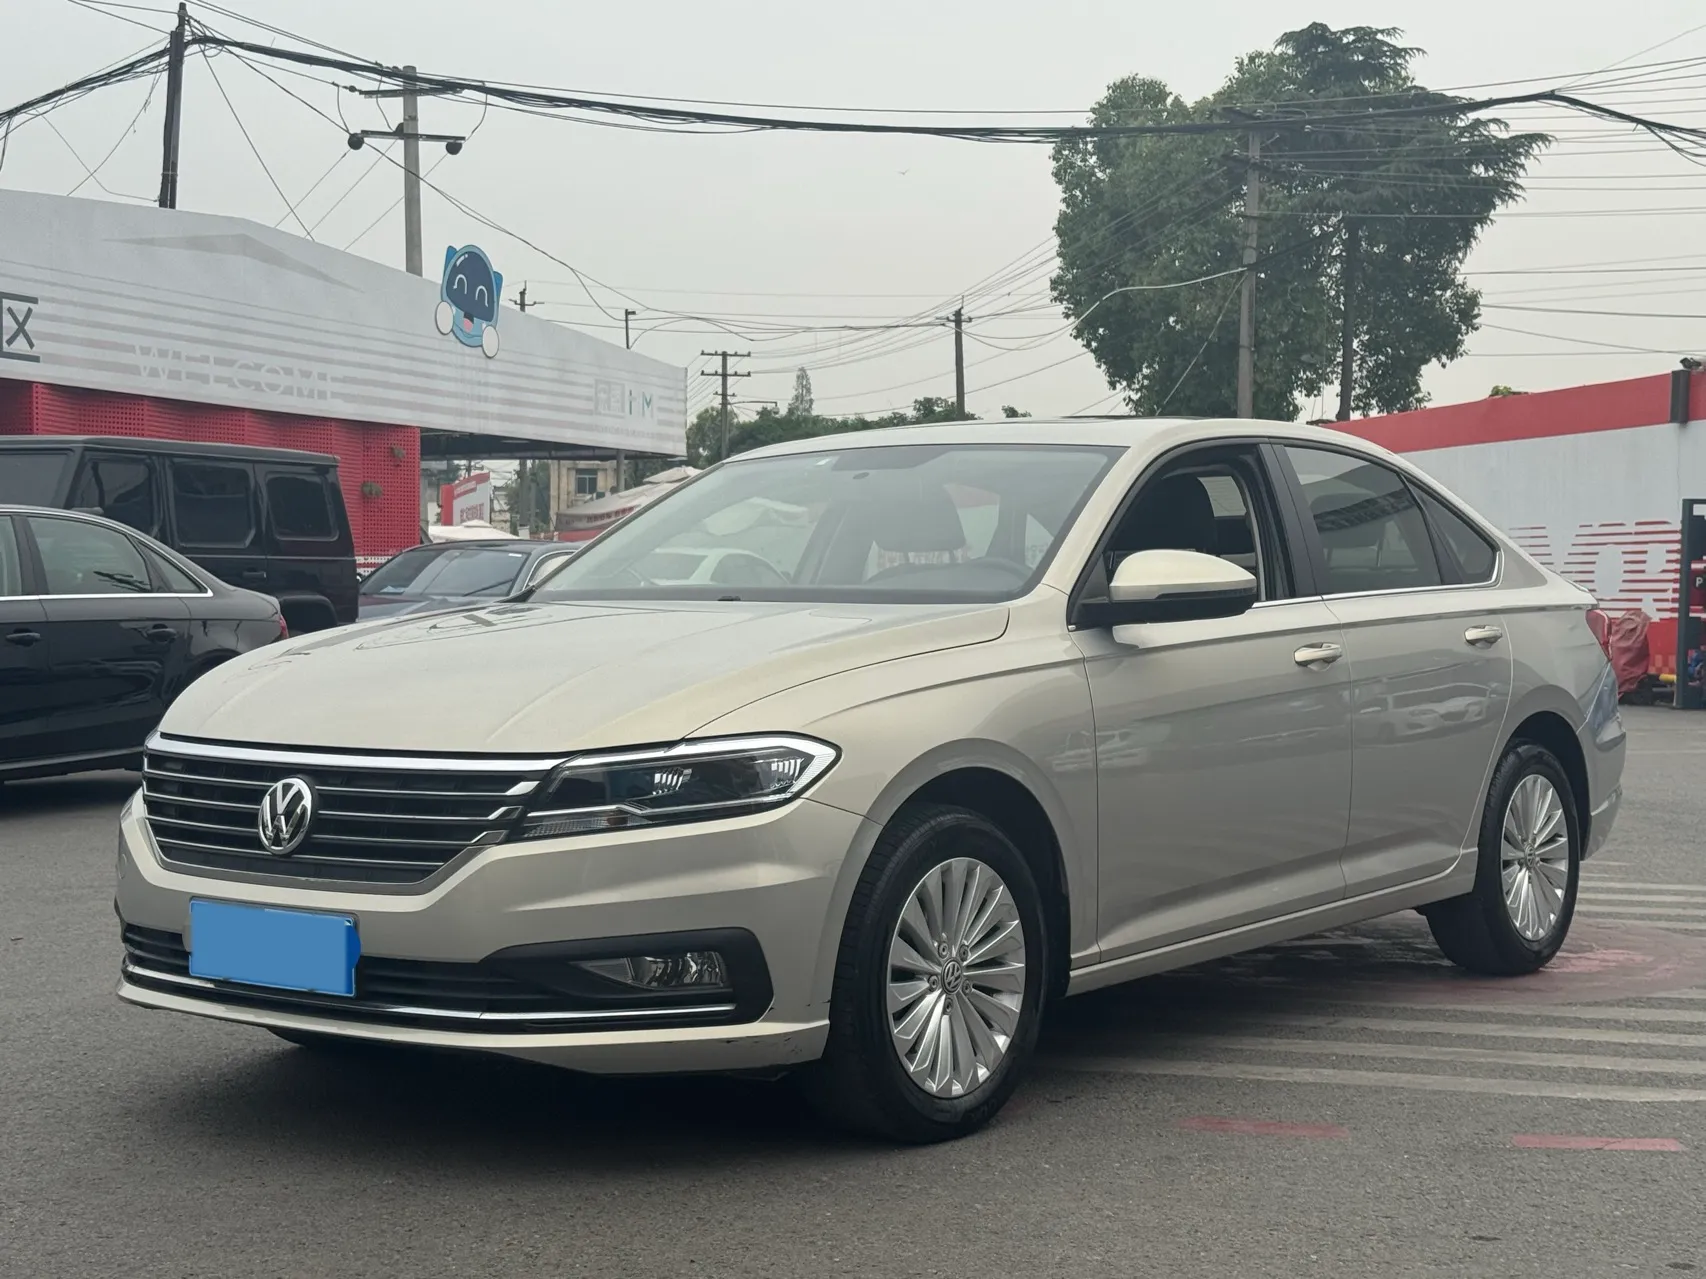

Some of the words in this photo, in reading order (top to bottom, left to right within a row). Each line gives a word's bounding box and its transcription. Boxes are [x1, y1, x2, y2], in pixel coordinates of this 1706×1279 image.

[0, 291, 41, 363] 区
[134, 344, 344, 400] WELCOME
[259, 778, 312, 855] VW
